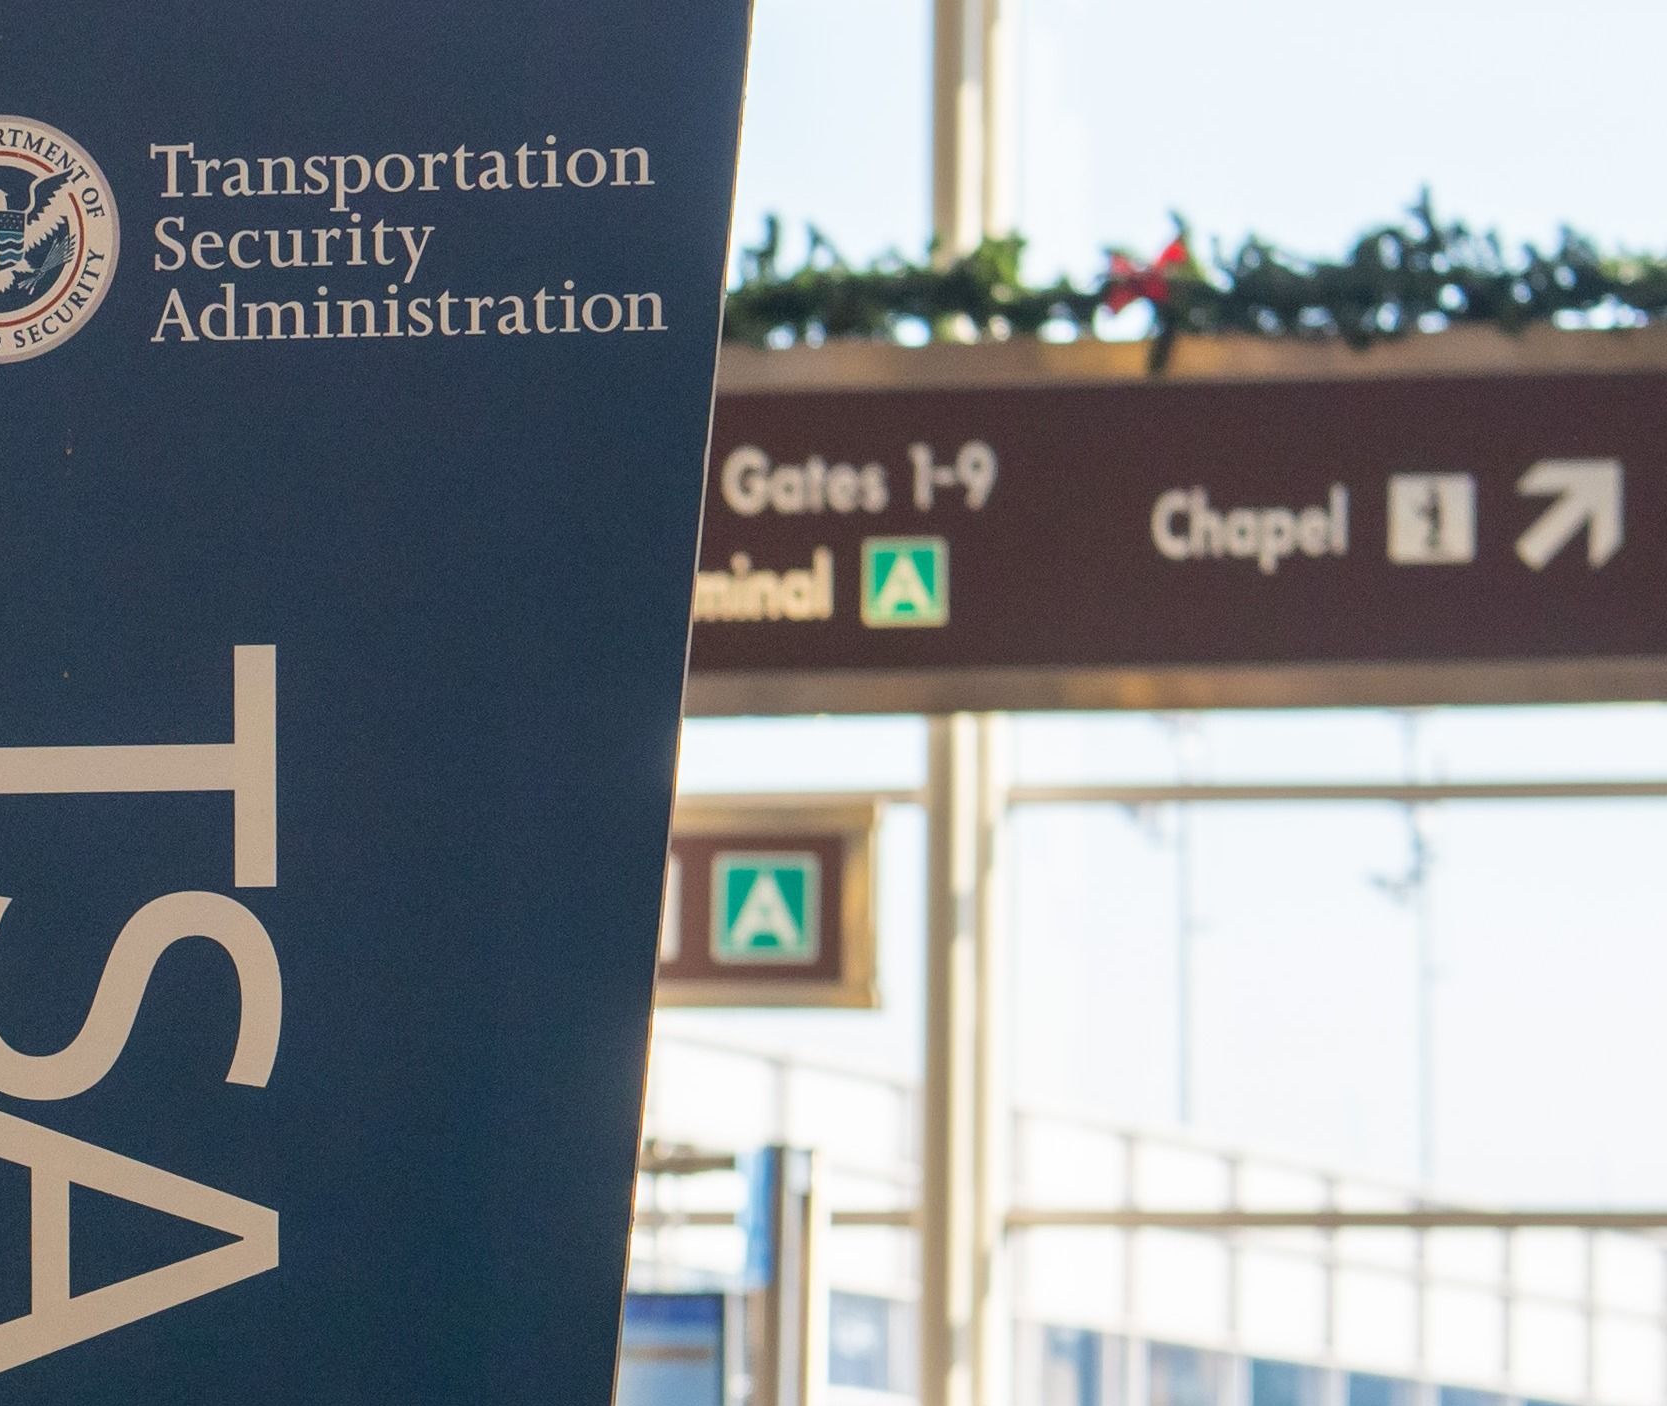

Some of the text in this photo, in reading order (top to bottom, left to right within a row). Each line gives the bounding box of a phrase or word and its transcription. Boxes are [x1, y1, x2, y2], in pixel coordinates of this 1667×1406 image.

[81, 187, 106, 219] OF
[150, 134, 655, 212] Transportation
[153, 212, 435, 284] Security
[13, 249, 106, 349] SECURITY
[150, 280, 669, 343] Administration
[721, 440, 999, 517] Gates 1-9
[1150, 481, 1350, 576] Chapel
[693, 545, 937, 622] minal A
[724, 862, 805, 951] A
